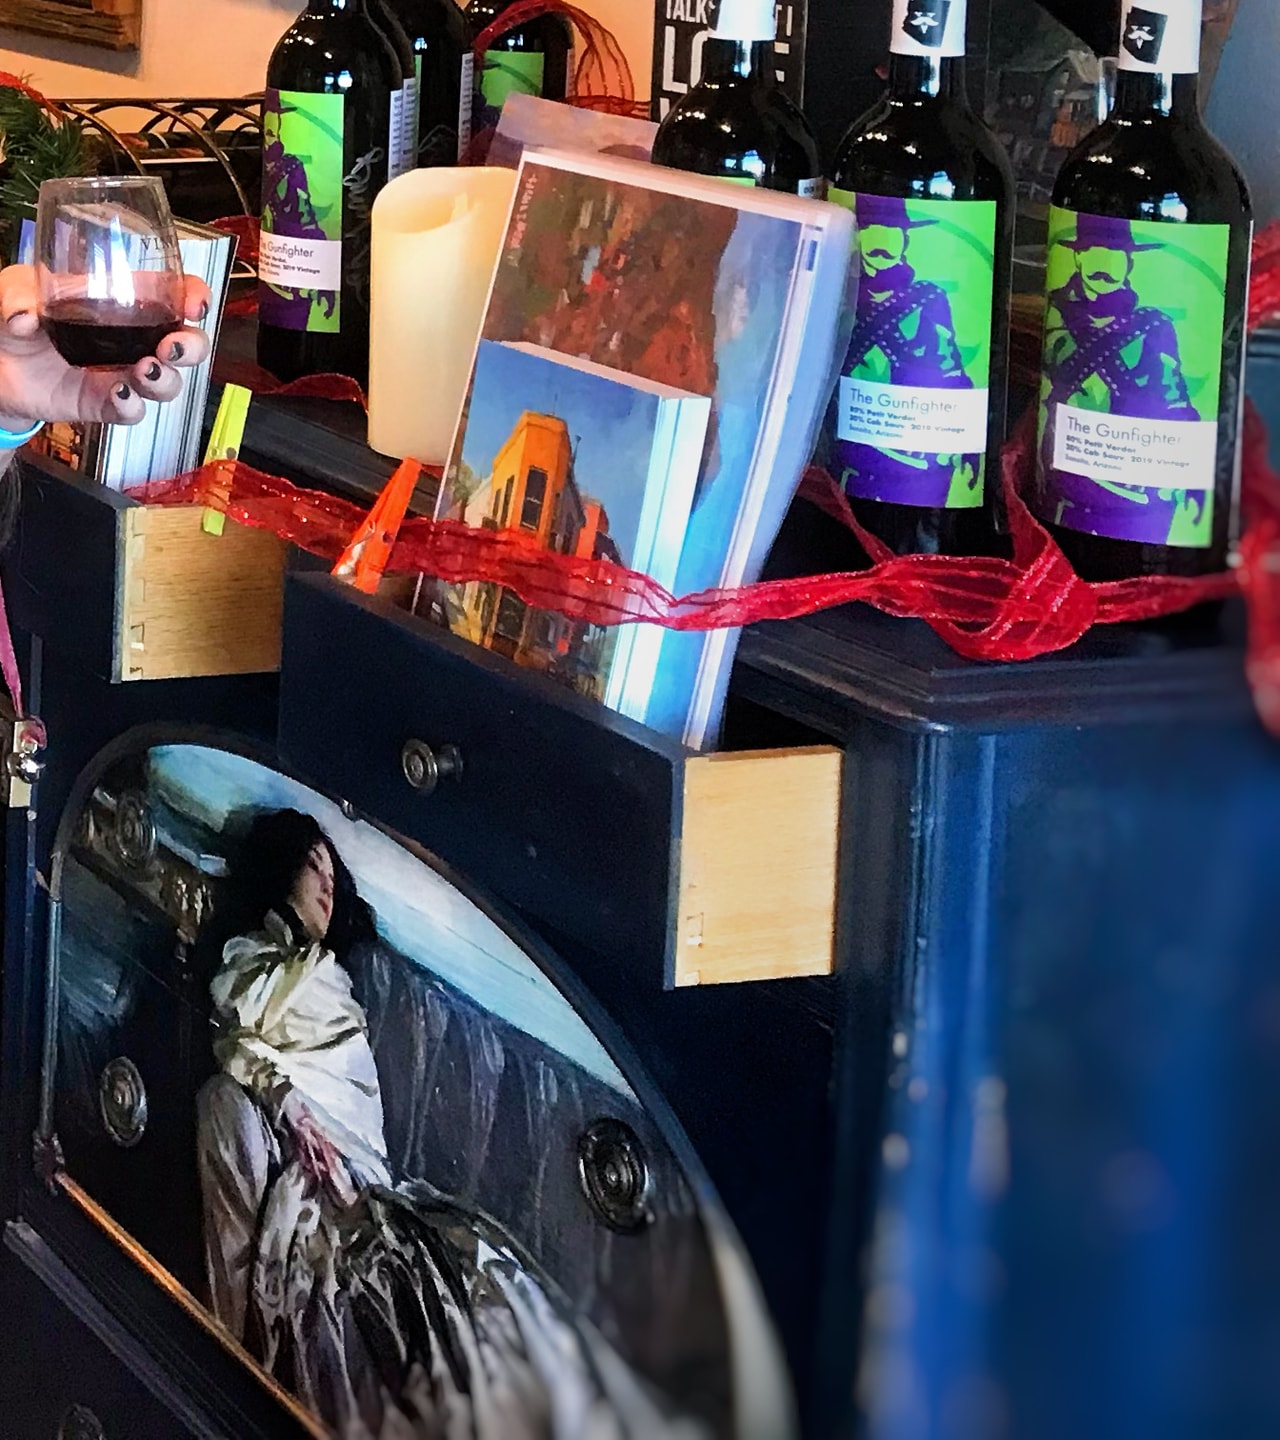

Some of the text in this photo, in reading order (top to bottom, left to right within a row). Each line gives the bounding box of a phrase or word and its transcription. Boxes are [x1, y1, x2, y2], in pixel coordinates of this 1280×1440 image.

[268, 241, 314, 258] Gunfighter
[850, 388, 958, 414] The Gunfighter
[1067, 416, 1181, 446] The Gunfighter
